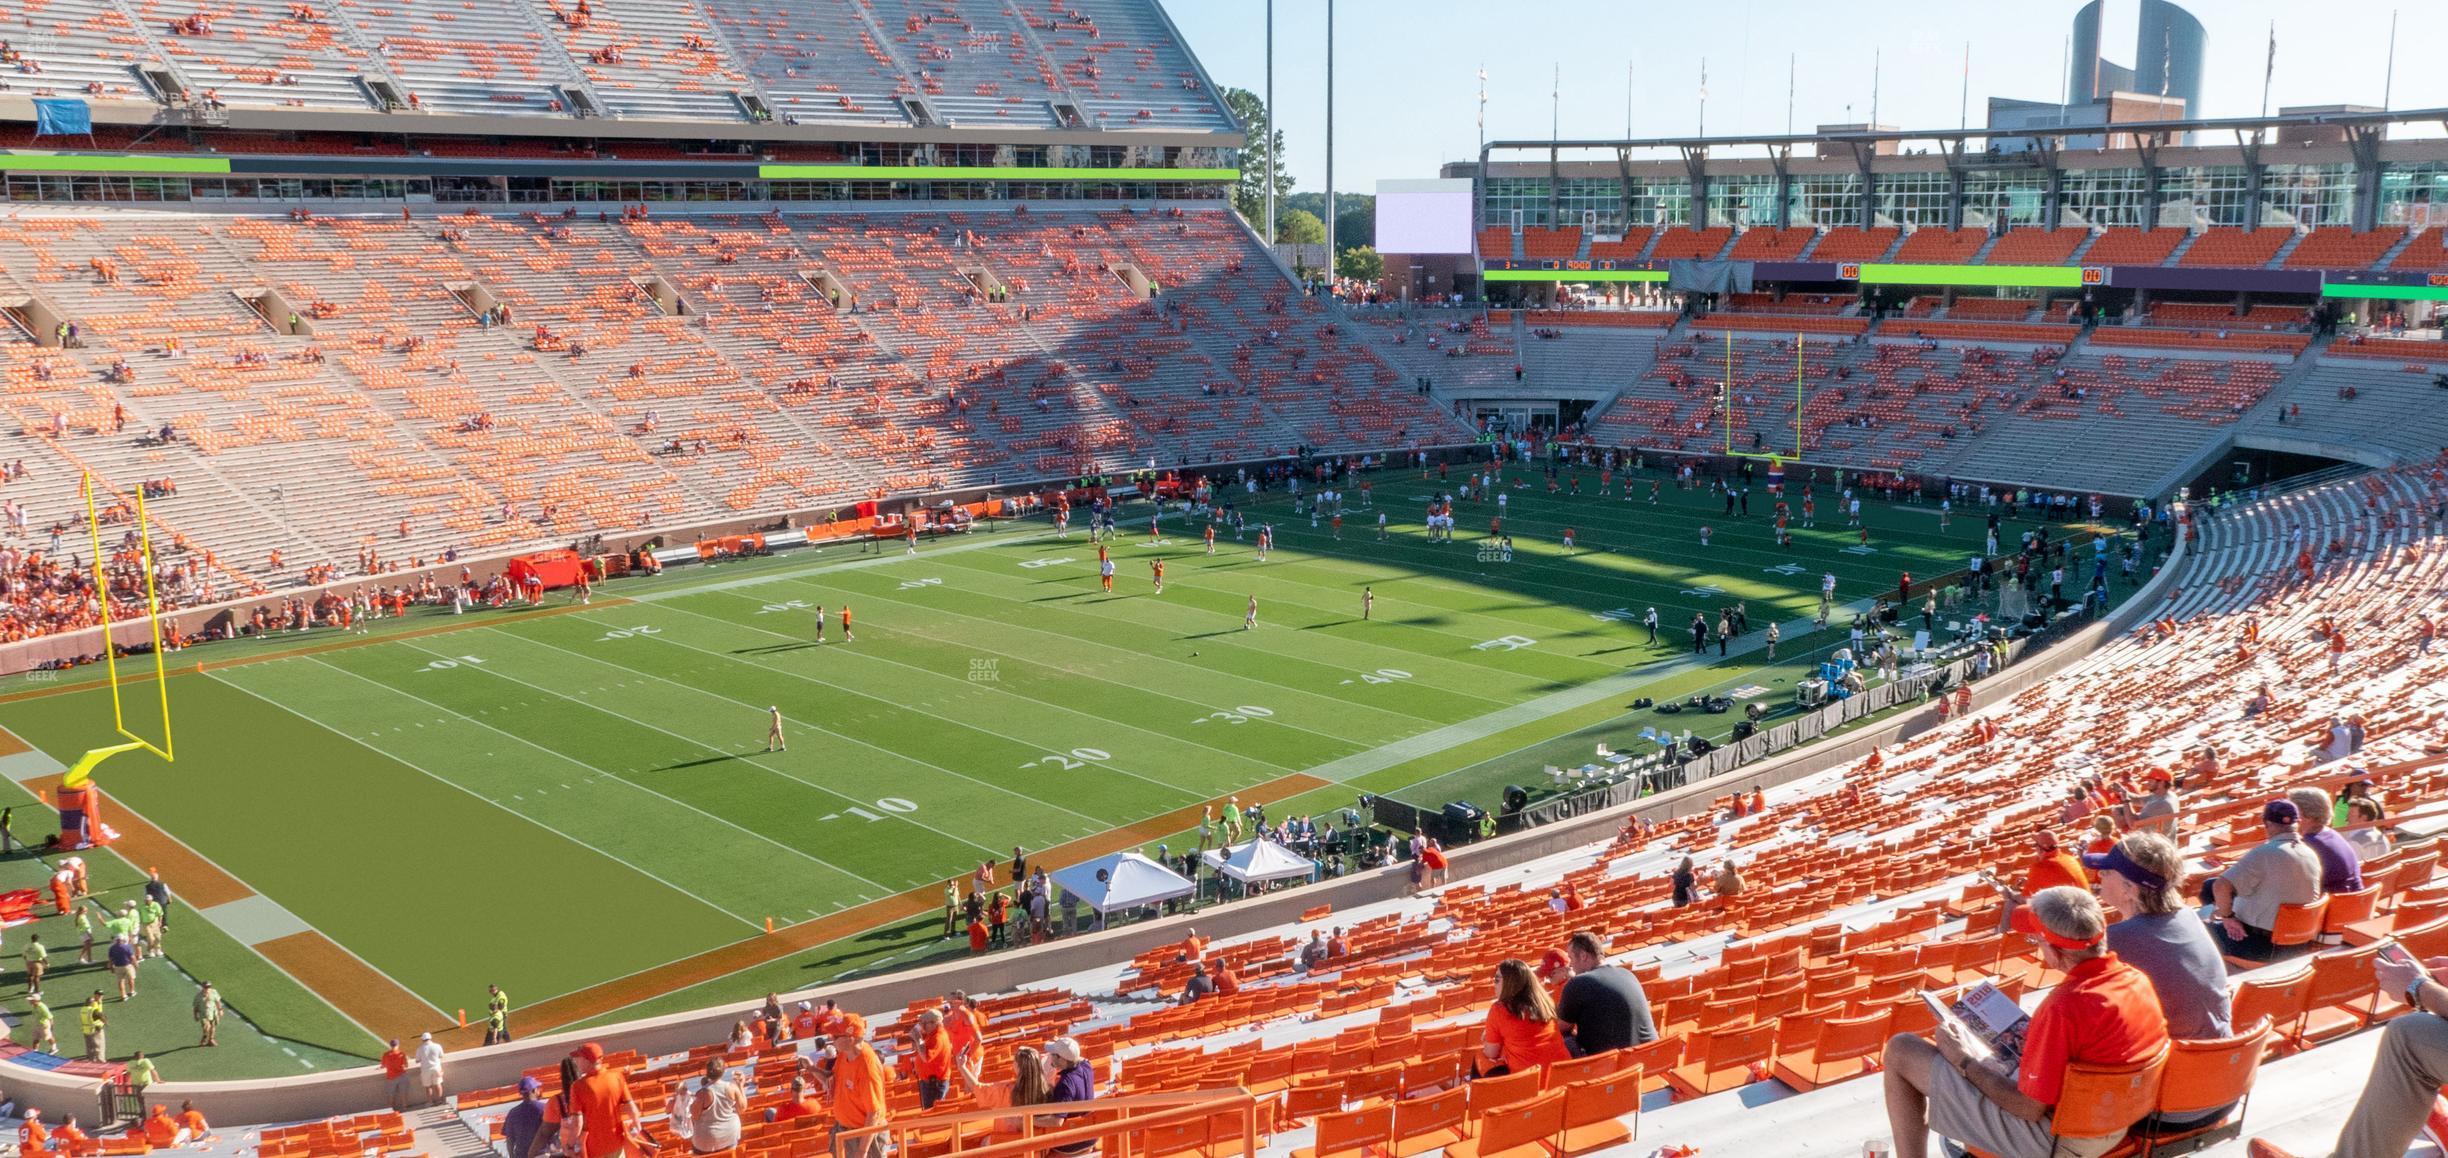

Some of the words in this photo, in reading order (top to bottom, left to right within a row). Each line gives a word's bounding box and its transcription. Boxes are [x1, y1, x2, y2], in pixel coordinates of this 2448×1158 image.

[1504, 260, 1511, 270] 3
[1553, 260, 1560, 270] 0
[1604, 261, 1611, 270] 0
[1843, 266, 1858, 278] 00
[2084, 270, 2101, 282] 00
[1017, 557, 1076, 568] 50
[1762, 565, 1807, 576] 20
[906, 577, 944, 588] 40
[1679, 587, 1726, 598] 30
[766, 600, 814, 612] 30
[1589, 610, 1636, 622] 40
[606, 625, 662, 639] 20
[1471, 635, 1538, 652] 50
[428, 655, 488, 670] 10
[1360, 668, 1413, 686] 40
[1210, 705, 1275, 725] 30
[1041, 747, 1112, 771] 20
[842, 797, 919, 824] 10
[20, 1128, 29, 1143] 9
